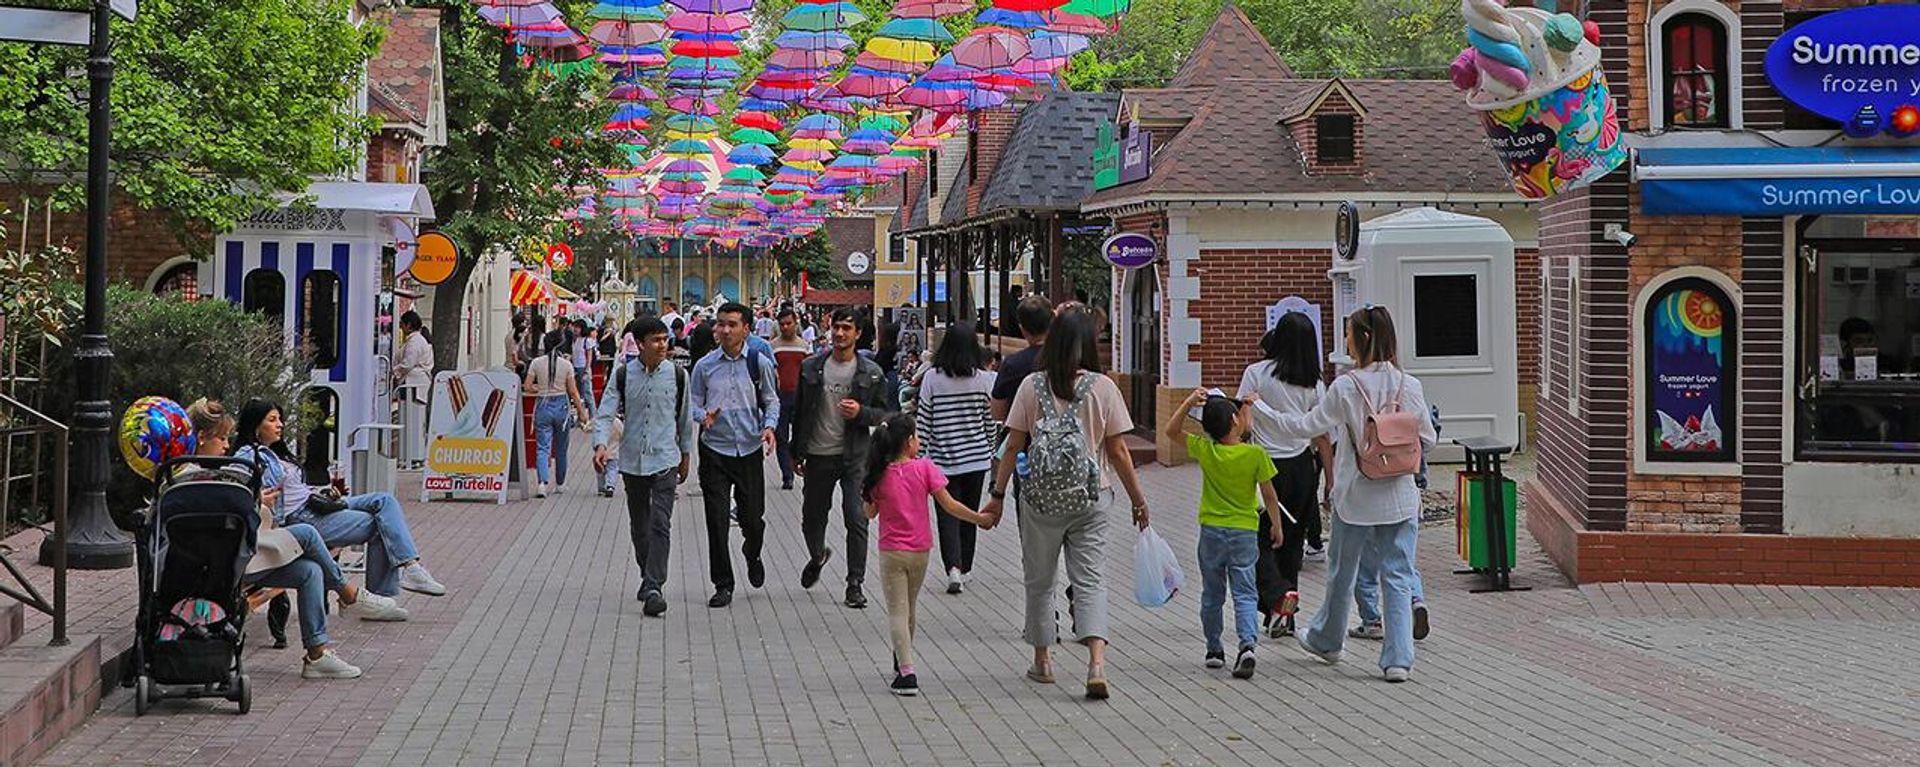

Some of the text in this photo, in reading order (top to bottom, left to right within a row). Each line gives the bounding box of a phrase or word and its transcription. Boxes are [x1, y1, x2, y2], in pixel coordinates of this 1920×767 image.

[1822, 74, 1898, 93] frozen
[1509, 132, 1546, 147] Love
[1762, 184, 1871, 206] Summer
[1659, 374, 1717, 382] Summer Love
[435, 447, 502, 465] CHURROS
[454, 477, 502, 490] nutella
